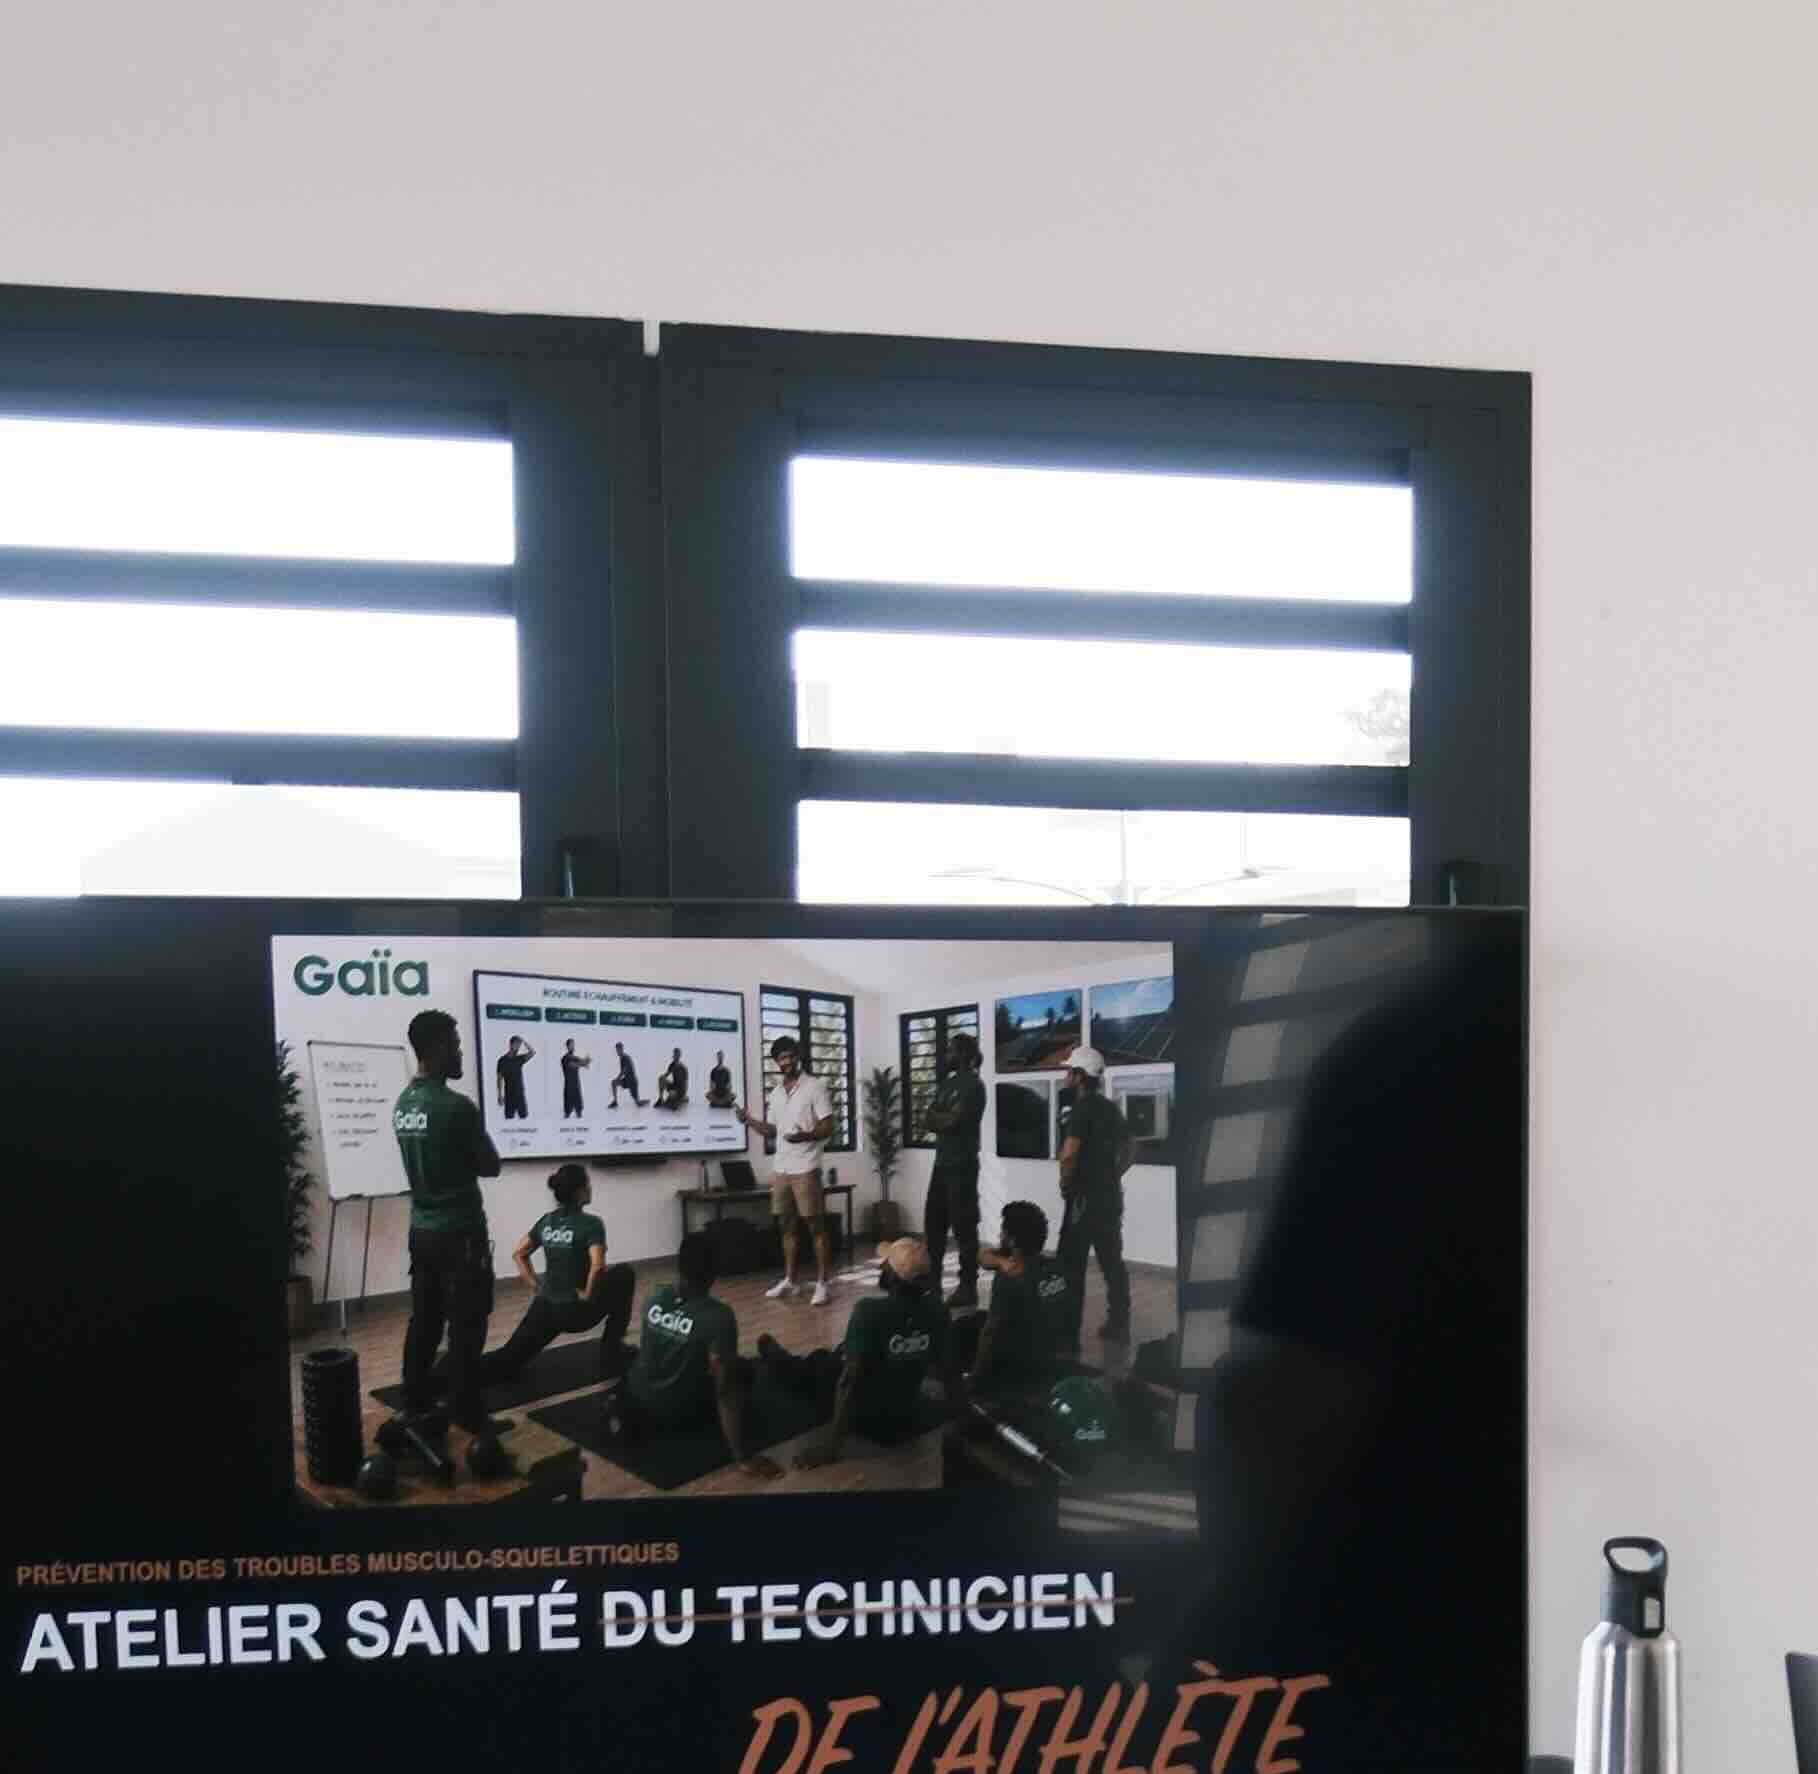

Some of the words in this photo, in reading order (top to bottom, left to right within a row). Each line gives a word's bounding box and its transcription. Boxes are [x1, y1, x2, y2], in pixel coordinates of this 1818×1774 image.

[293, 948, 430, 996] Gaïa
[16, 1559, 172, 1587] PRÉVENTION
[179, 1557, 226, 1581] DES
[234, 1552, 361, 1578] TROUBLES
[367, 1541, 680, 1574] MUSCULO-SQUELETTIQUES
[20, 1602, 328, 1673] ATELIER
[346, 1578, 581, 1660] SANTÉ
[601, 1588, 696, 1649] DU
[716, 1571, 1116, 1644] TECHNICIEN
